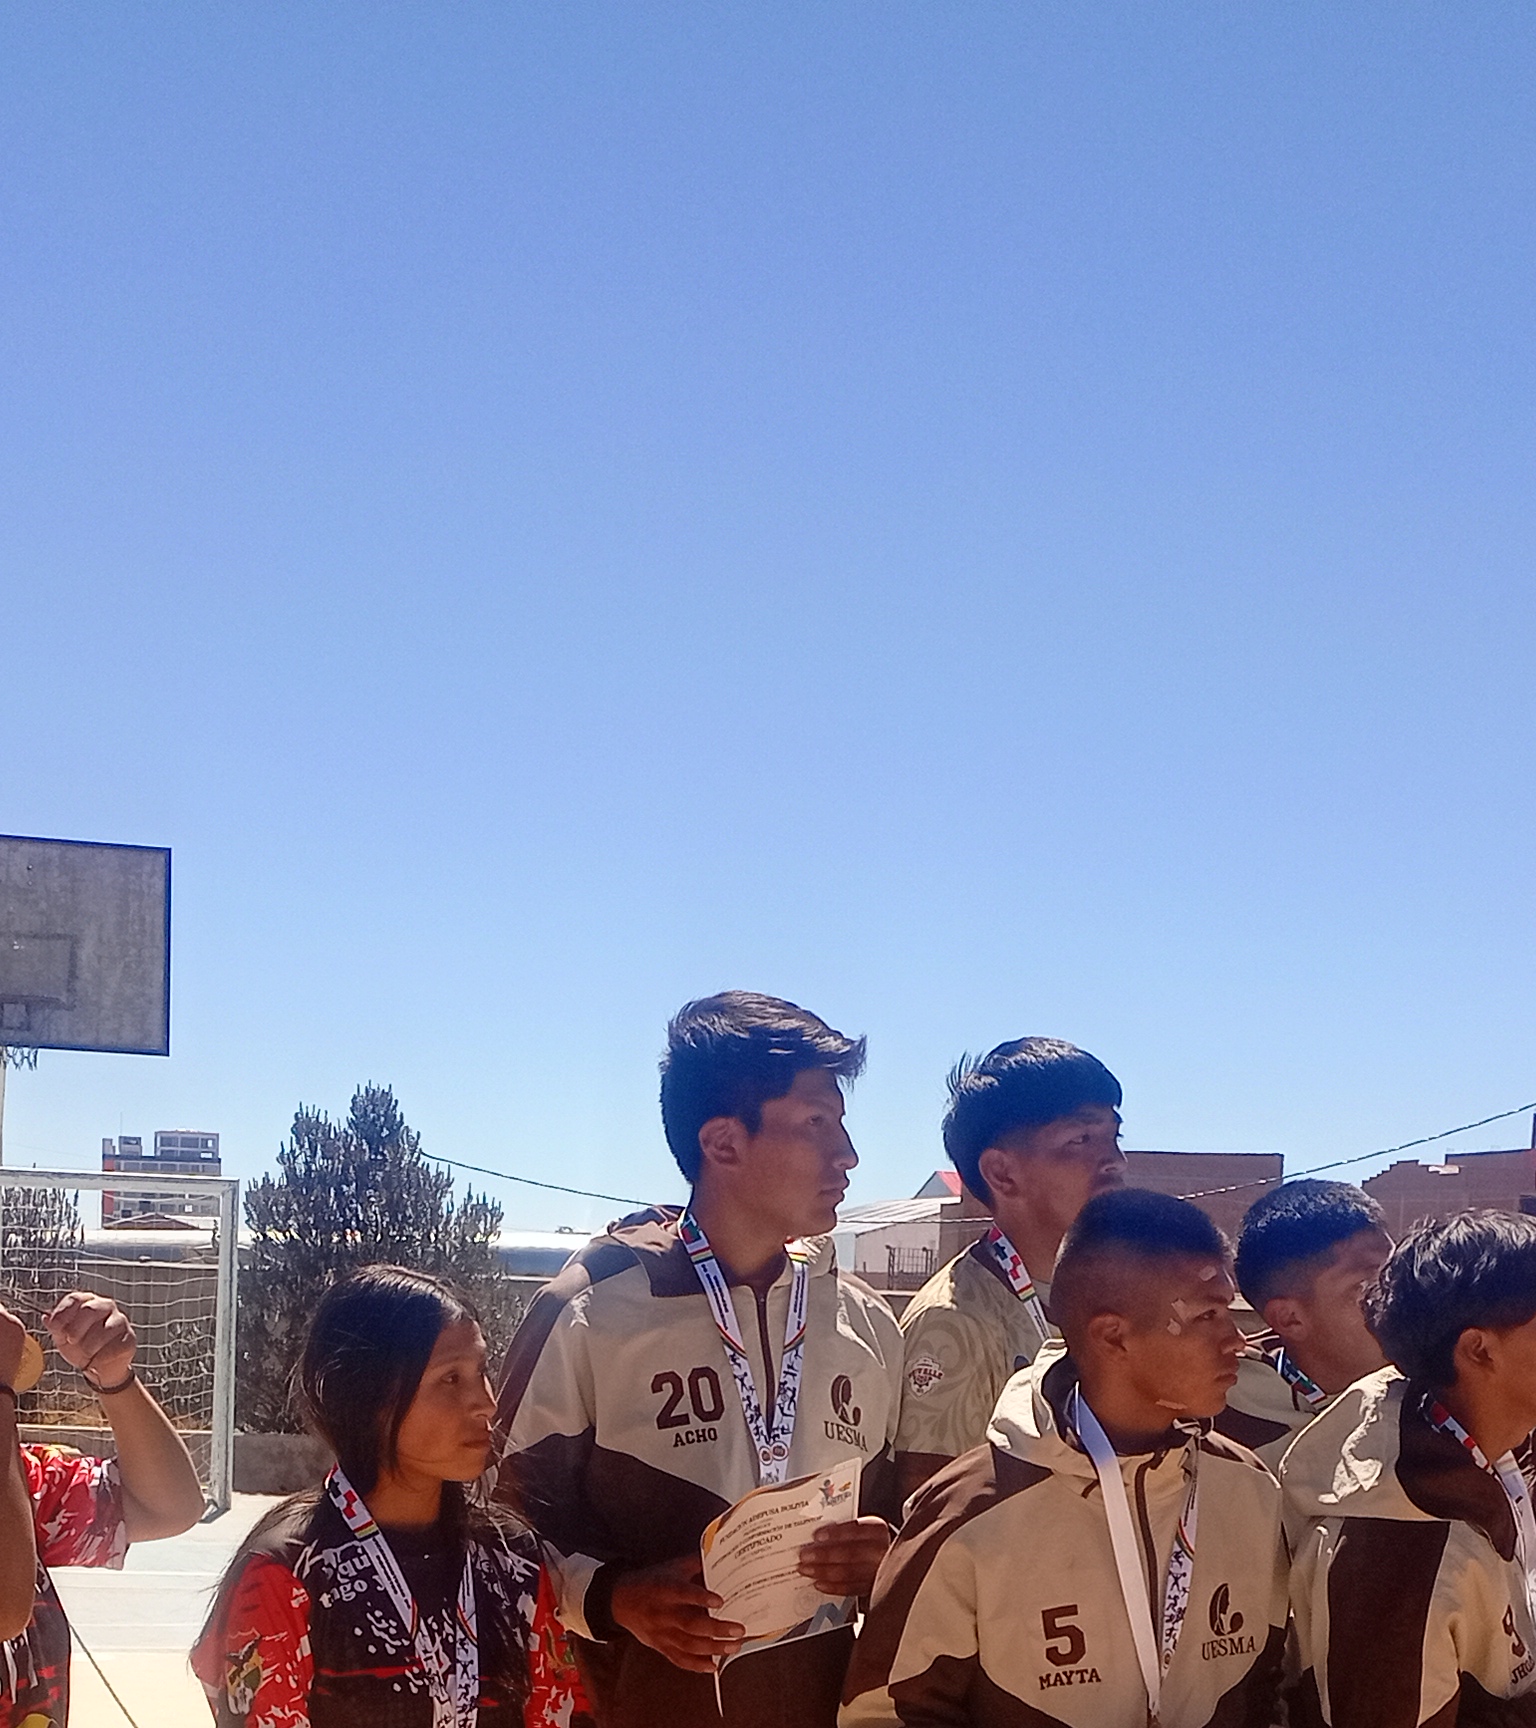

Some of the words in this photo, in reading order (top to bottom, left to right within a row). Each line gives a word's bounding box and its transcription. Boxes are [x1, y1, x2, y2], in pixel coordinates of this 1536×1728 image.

[650, 1365, 727, 1431] 20
[672, 1427, 719, 1448] ACHO
[1041, 1604, 1087, 1667] 5
[1201, 1635, 1257, 1661] UESMA
[1038, 1667, 1102, 1690] MAYTA
